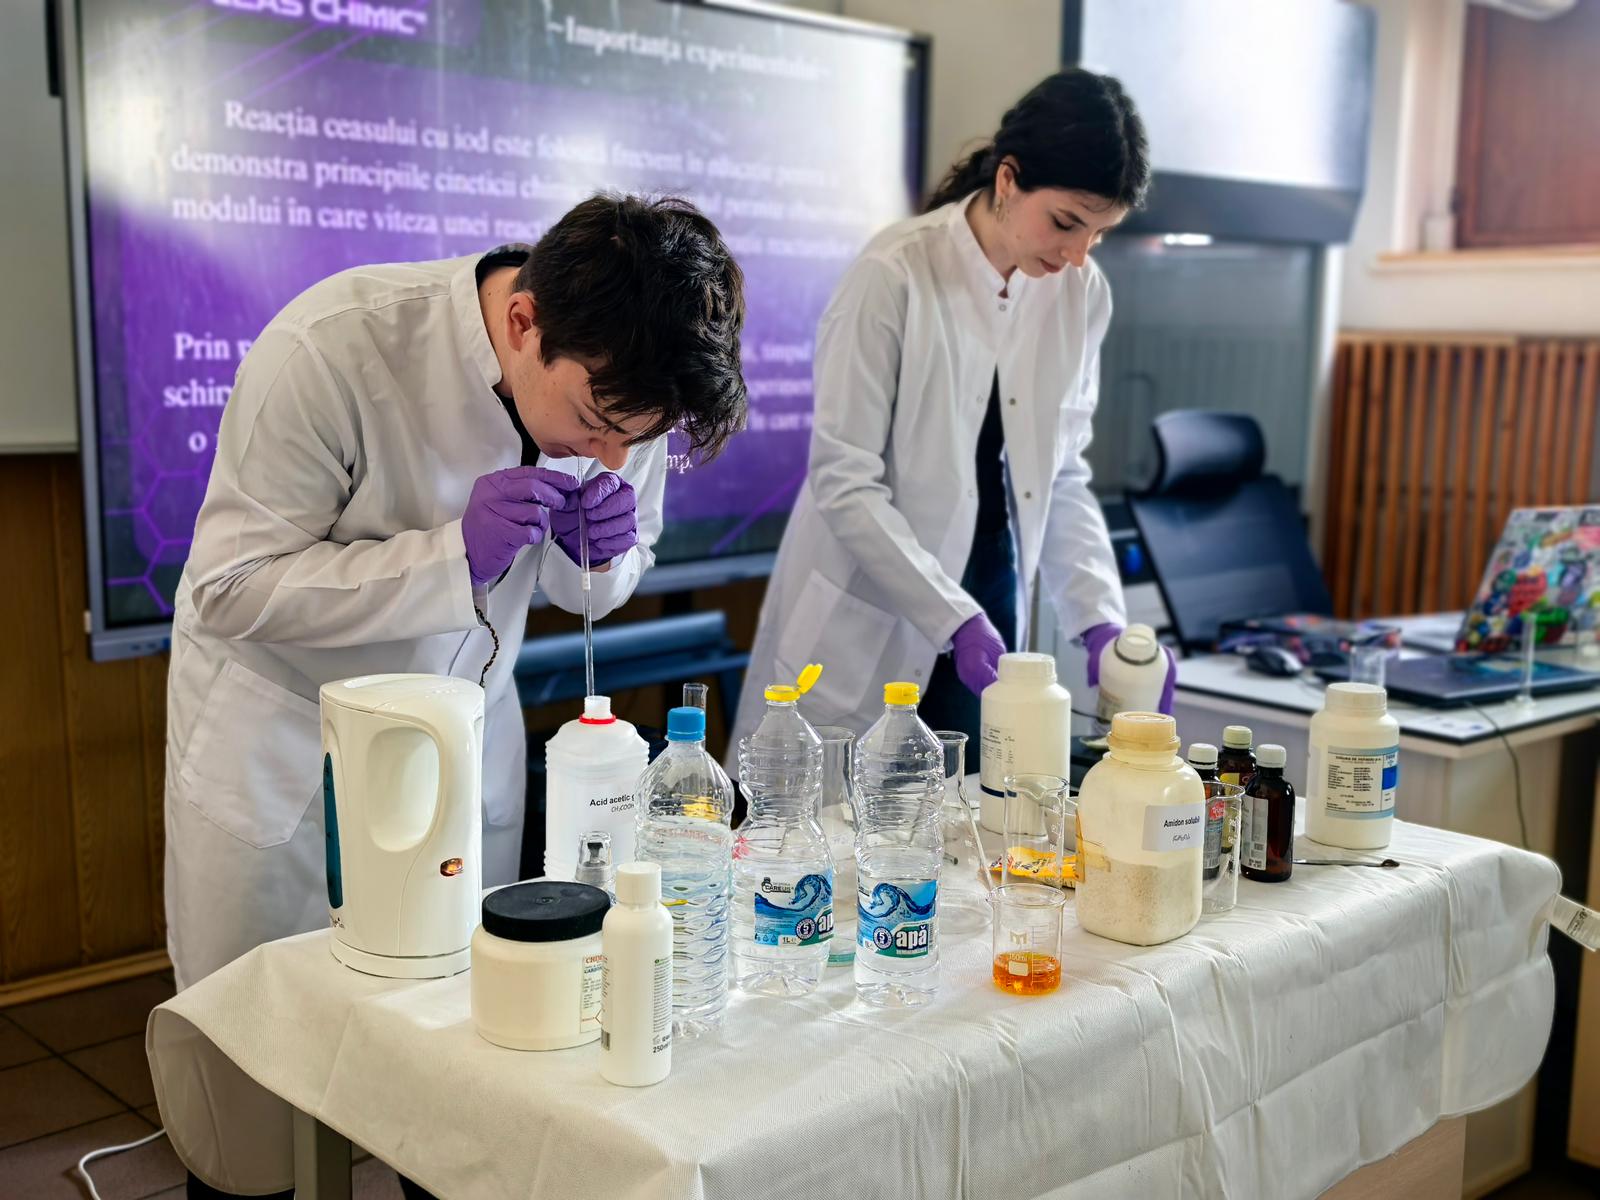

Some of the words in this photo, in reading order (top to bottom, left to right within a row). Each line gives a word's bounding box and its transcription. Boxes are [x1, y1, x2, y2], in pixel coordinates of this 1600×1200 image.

[225, 100, 317, 138] Reacția
[324, 116, 417, 147] ceasului
[421, 127, 449, 150] cu
[453, 124, 489, 153] iod
[493, 137, 532, 157] este
[171, 144, 308, 183] demonstra
[314, 156, 431, 193] principiile
[434, 165, 517, 197] cineticii
[171, 193, 281, 228] modului
[317, 207, 367, 232] care
[372, 203, 438, 236] viteza
[442, 210, 490, 237] unei
[174, 333, 230, 361] Prin
[188, 431, 208, 453] o
[590, 798, 608, 807] Acid
[609, 794, 631, 805] acetic
[1164, 819, 1185, 828] Amidon
[896, 925, 927, 949] apă
